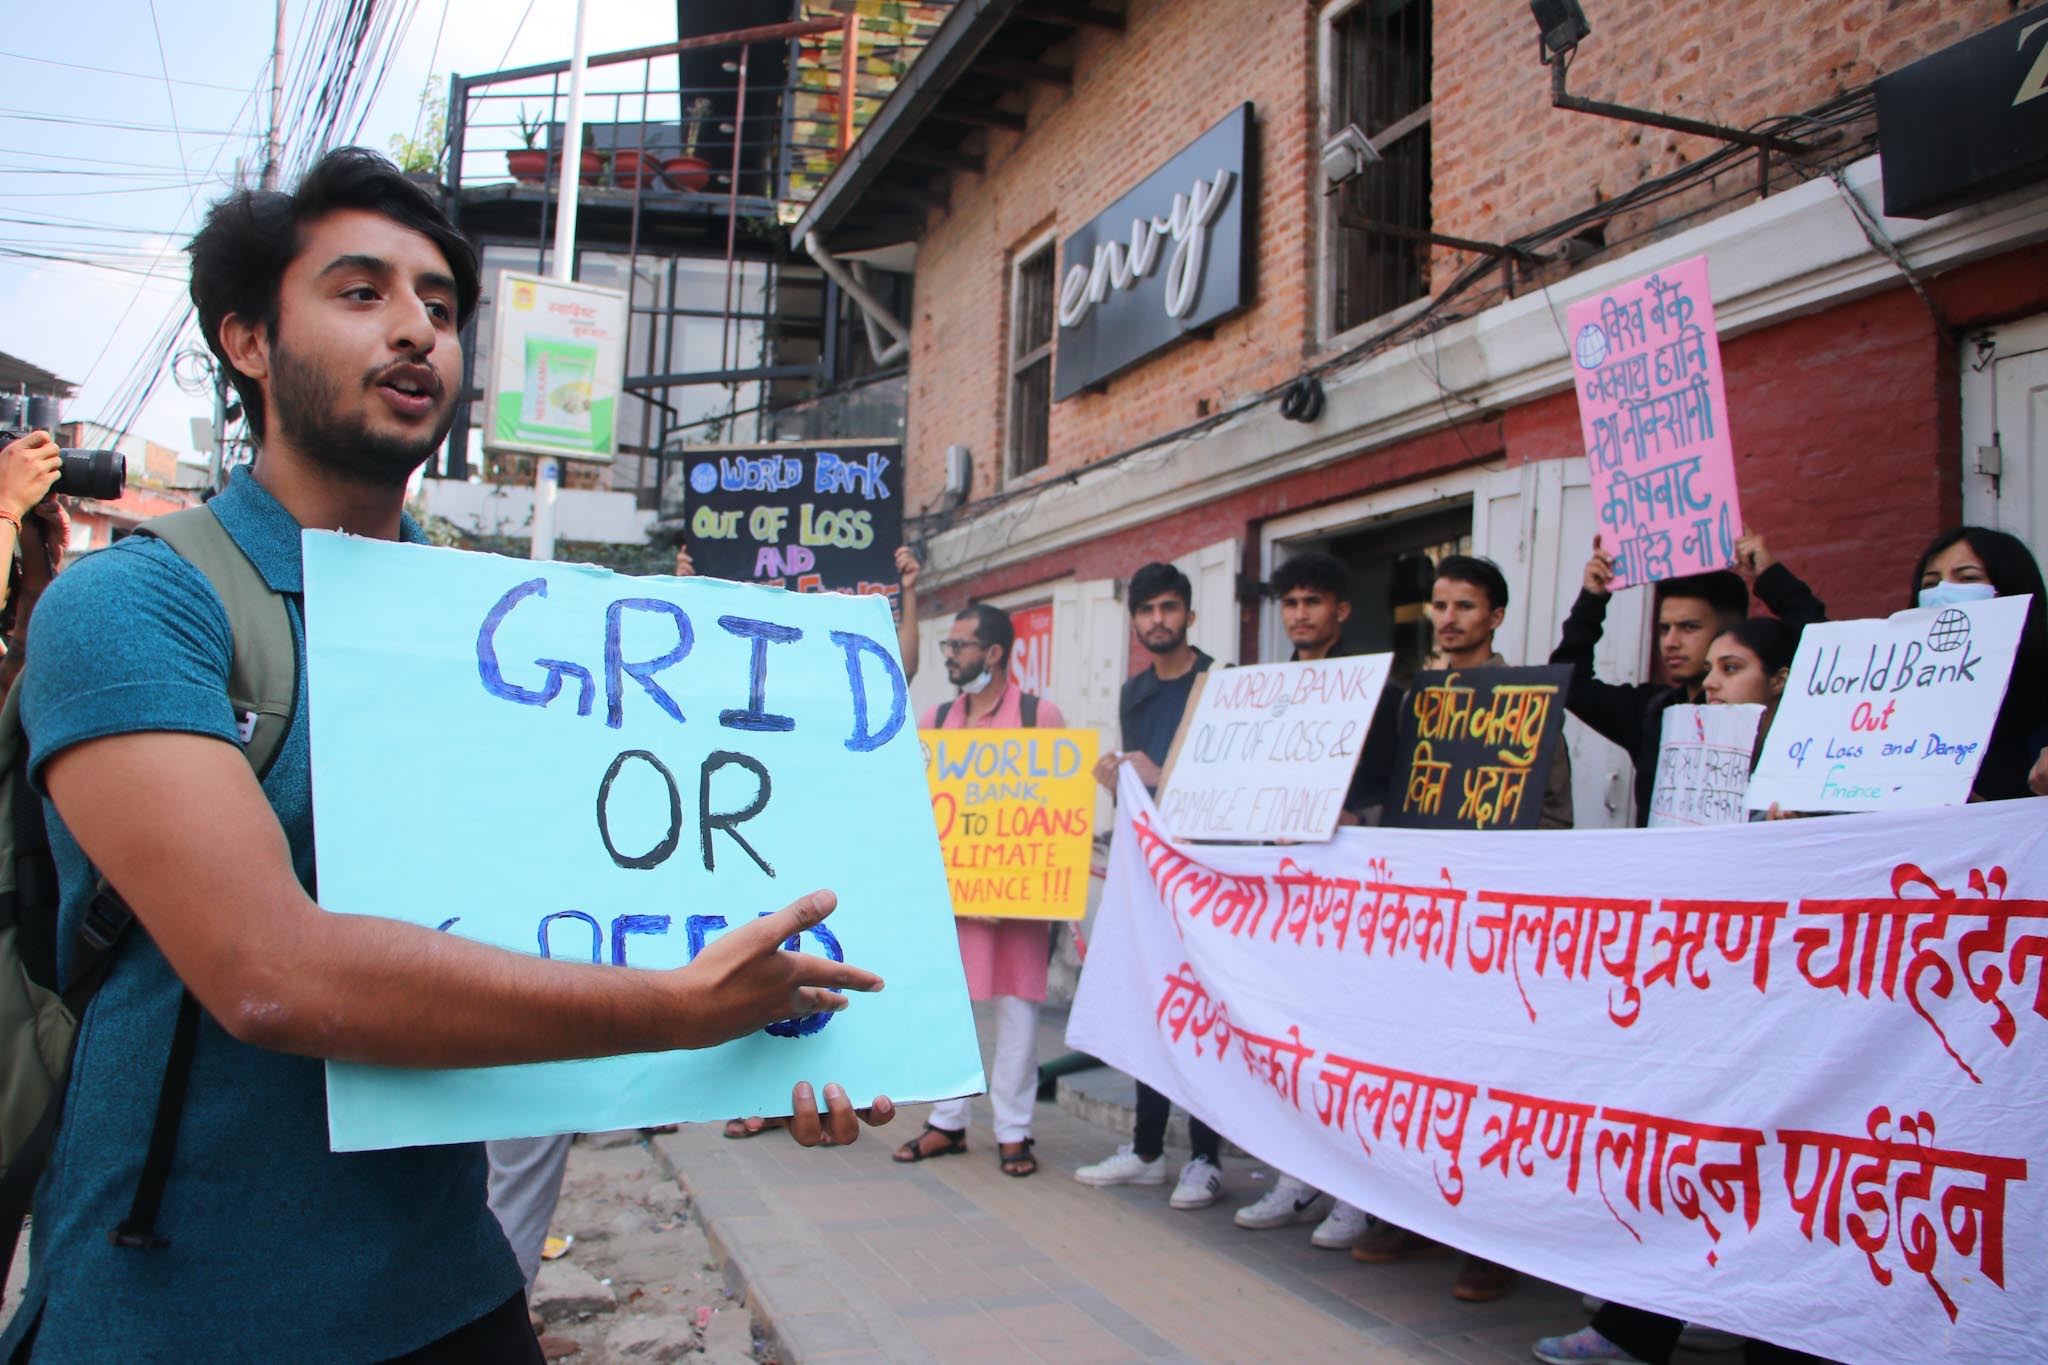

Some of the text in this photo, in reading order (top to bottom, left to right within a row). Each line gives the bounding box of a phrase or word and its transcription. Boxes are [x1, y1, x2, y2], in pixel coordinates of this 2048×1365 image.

[1058, 168, 1231, 328] envy
[1654, 323, 1707, 386] हानि
[719, 454, 803, 493] WORLD
[692, 503, 874, 550] OUT OF LOSS
[753, 544, 815, 578] AND
[475, 577, 909, 752] GRID
[1011, 637, 1052, 699] SAL
[1212, 665, 1377, 710] WORLD BANK
[1807, 640, 1983, 696] World Bank
[1850, 698, 1896, 732] Out
[936, 737, 1082, 782] WORLD
[1268, 718, 1332, 763] LOSS
[1328, 719, 1357, 758] &
[1881, 739, 1918, 757] and
[596, 749, 777, 879] OR
[931, 791, 957, 841] O
[995, 806, 1089, 838] LOANS
[1163, 786, 1342, 834] DAMAGE FINANCE
[941, 842, 1057, 869] LIMATE
[946, 876, 1032, 904] NANCE
[1271, 857, 1361, 952] विश्व
[1467, 889, 1652, 1029] जलवायु
[1643, 897, 1789, 994] ऋण
[1312, 1053, 1479, 1208] जलवायु
[1479, 1087, 1597, 1196] ऋण
